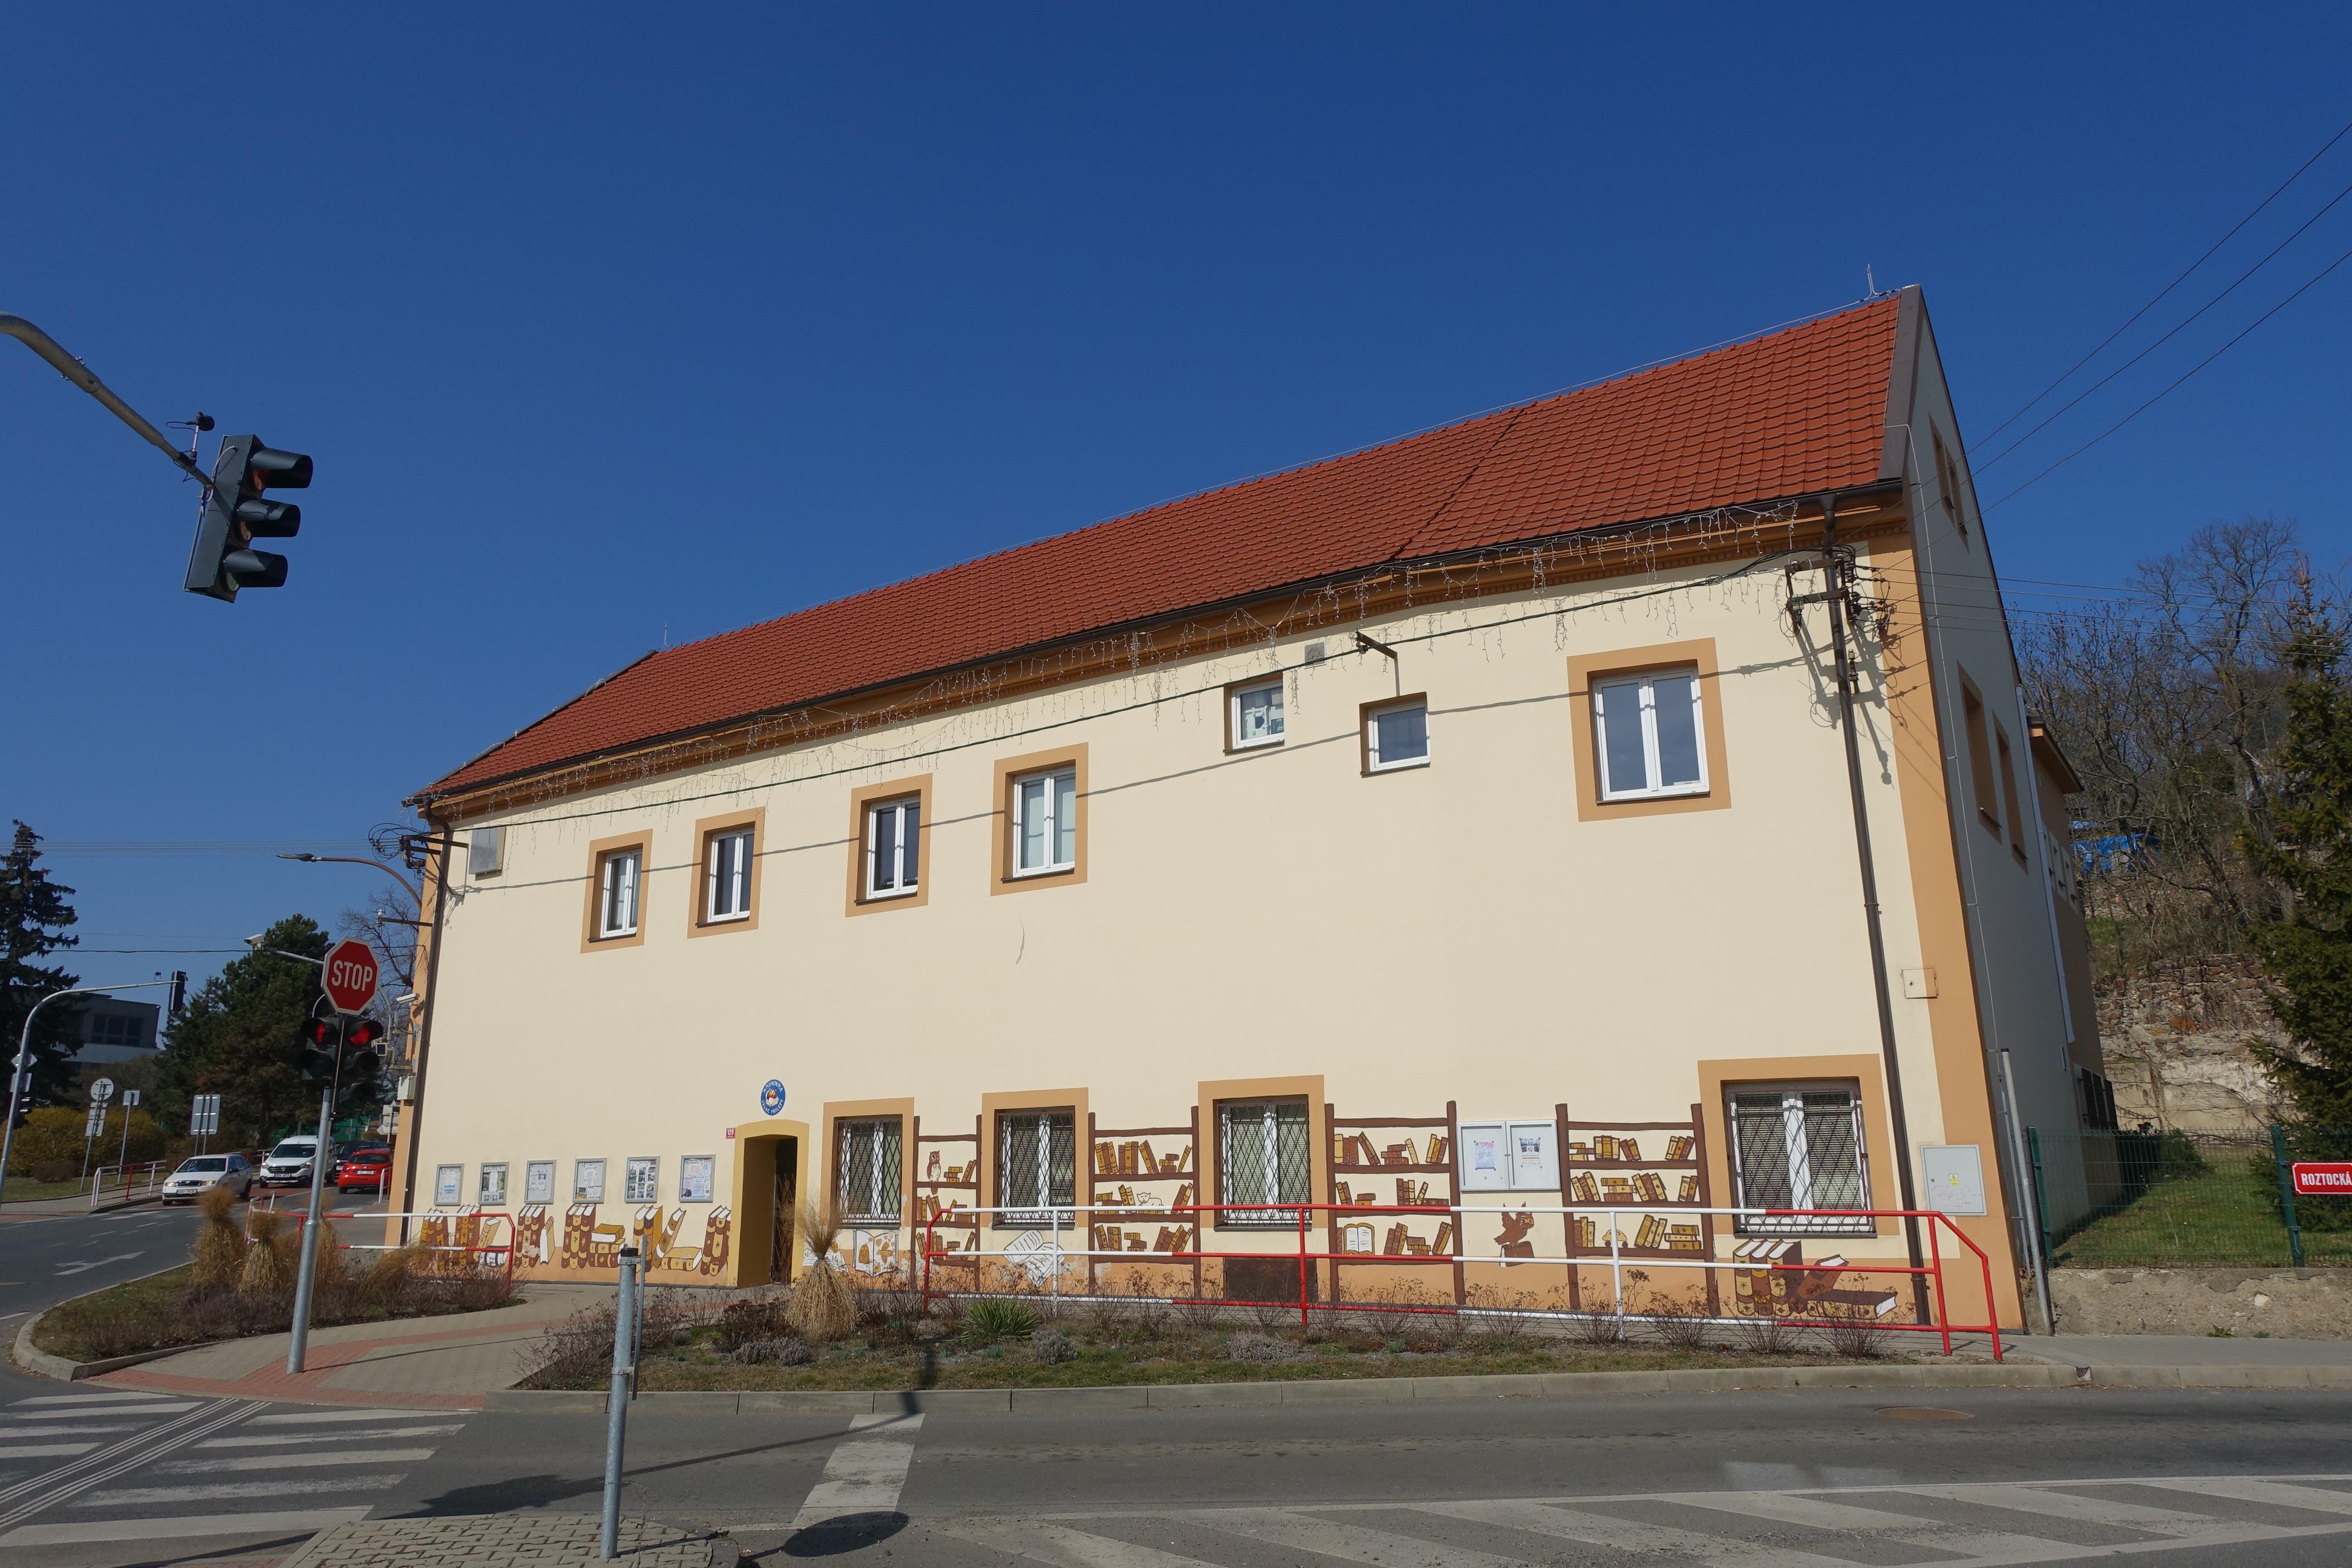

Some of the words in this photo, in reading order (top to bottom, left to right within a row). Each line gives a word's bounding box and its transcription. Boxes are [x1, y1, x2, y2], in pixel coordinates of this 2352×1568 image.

[332, 959, 373, 991] STOP
[763, 1080, 783, 1093] KNIHOVNA
[2301, 1171, 2352, 1186] ROZTOCKÁ
